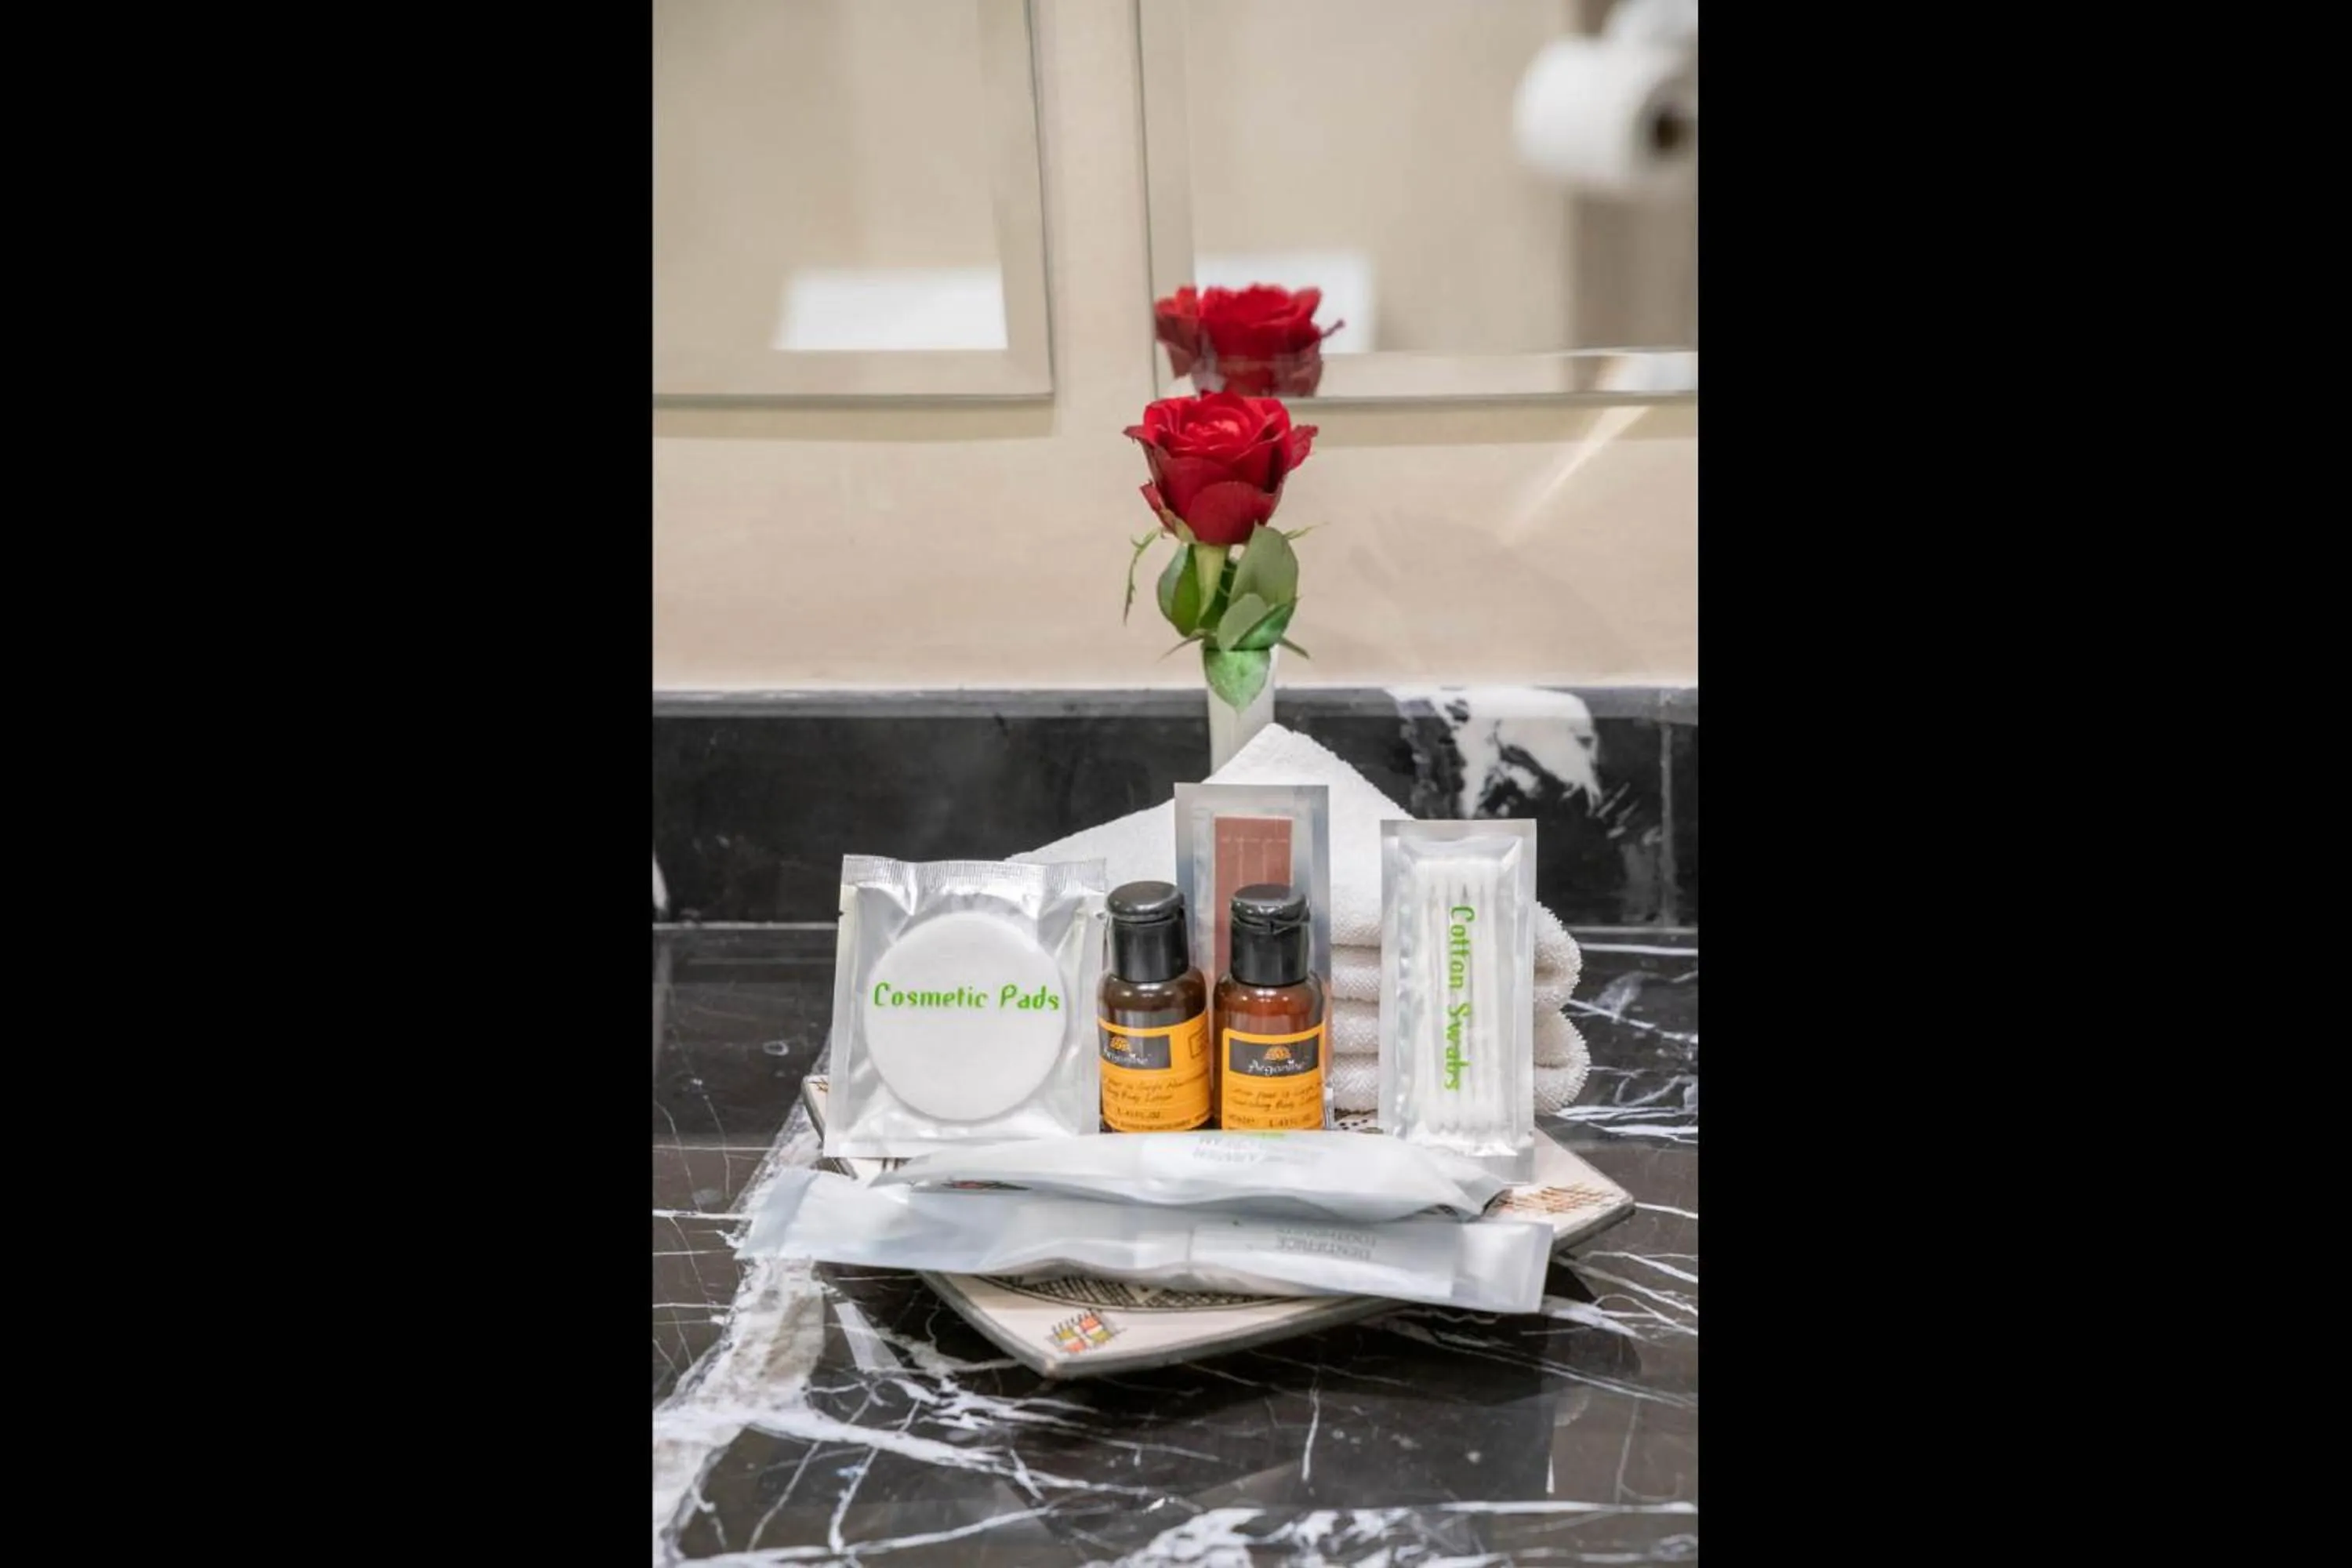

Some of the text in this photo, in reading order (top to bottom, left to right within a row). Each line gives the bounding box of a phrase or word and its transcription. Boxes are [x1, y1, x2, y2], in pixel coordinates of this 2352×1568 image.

[873, 982, 1060, 1011] Cosmetic Pads
[1443, 904, 1475, 1091] Cotton Swabs
